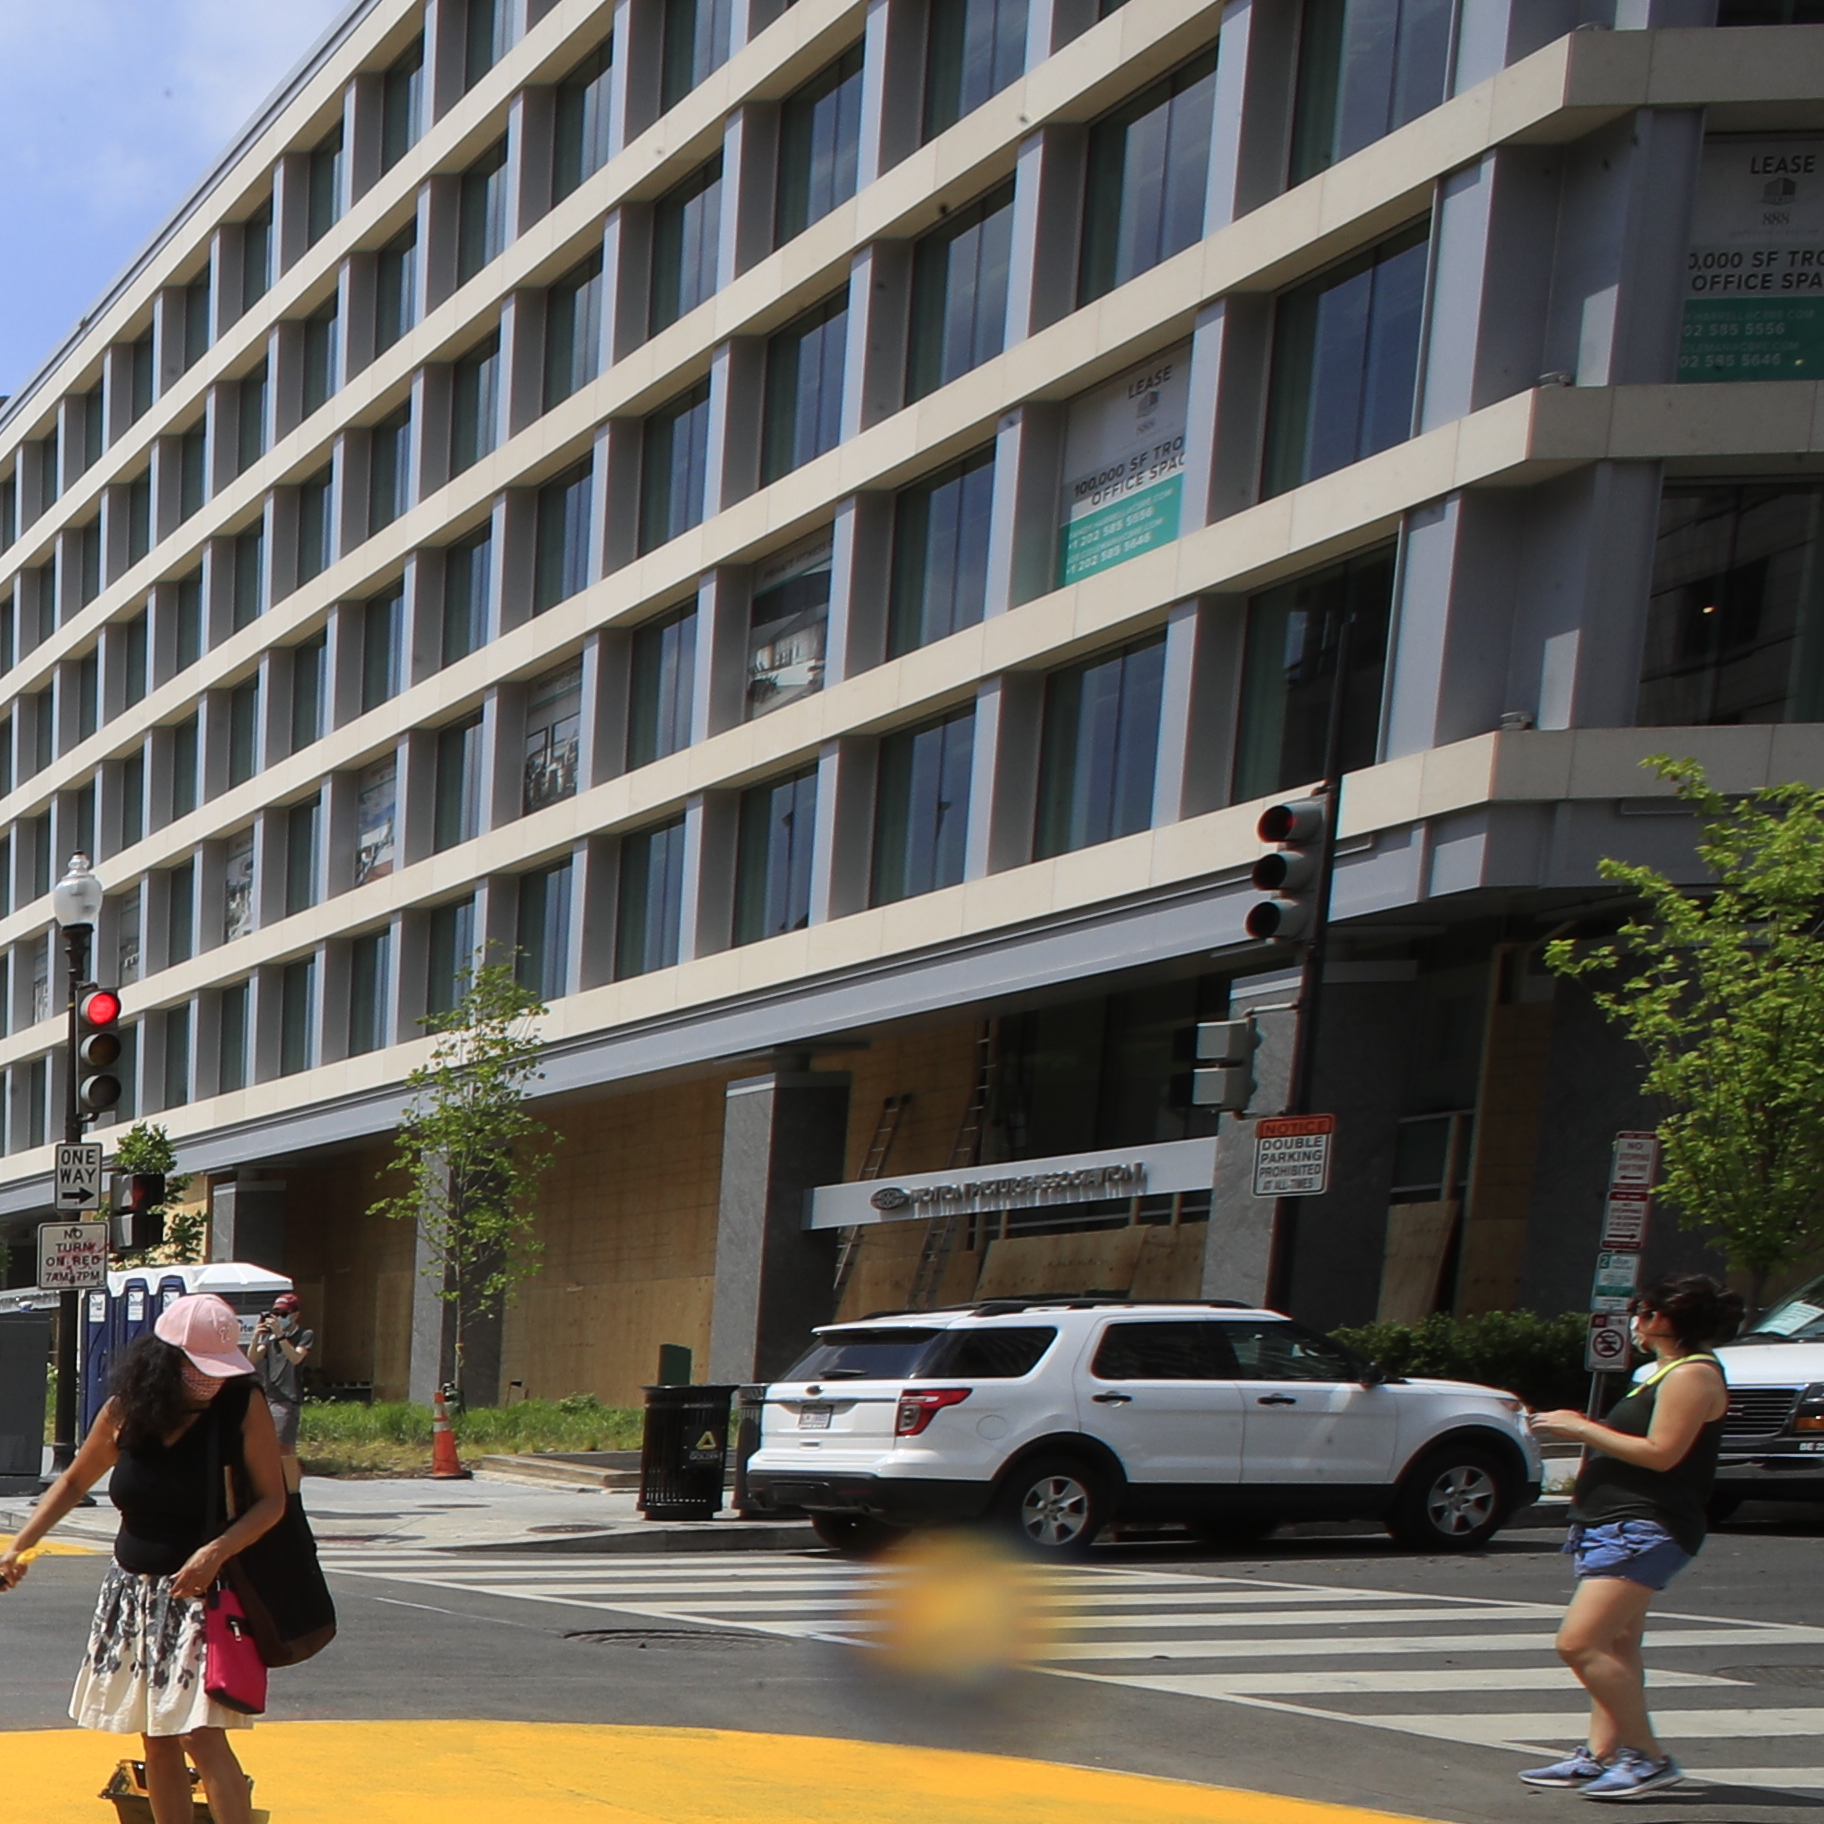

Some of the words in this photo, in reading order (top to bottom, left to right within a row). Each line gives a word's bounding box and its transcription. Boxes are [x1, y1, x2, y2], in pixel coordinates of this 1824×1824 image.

[1750, 155, 1816, 174] LEASE
[1752, 251, 1778, 268] SF
[1692, 273, 1773, 291] OFFICE
[1780, 272, 1824, 289] SPA
[1127, 365, 1172, 400] LEASE
[1129, 453, 1148, 471] SF
[1091, 471, 1144, 506] OFFICE
[1265, 1120, 1326, 1134] NOTICE
[1262, 1135, 1323, 1151] DOUBLE
[60, 1149, 96, 1165] ONE
[1260, 1150, 1323, 1164] PARKING
[60, 1167, 98, 1184] WAY
[1259, 1163, 1322, 1178] PROHIBITED
[63, 1229, 83, 1240] NO
[55, 1243, 95, 1254] TURN
[45, 1256, 65, 1267] ON
[72, 1255, 101, 1267] RED
